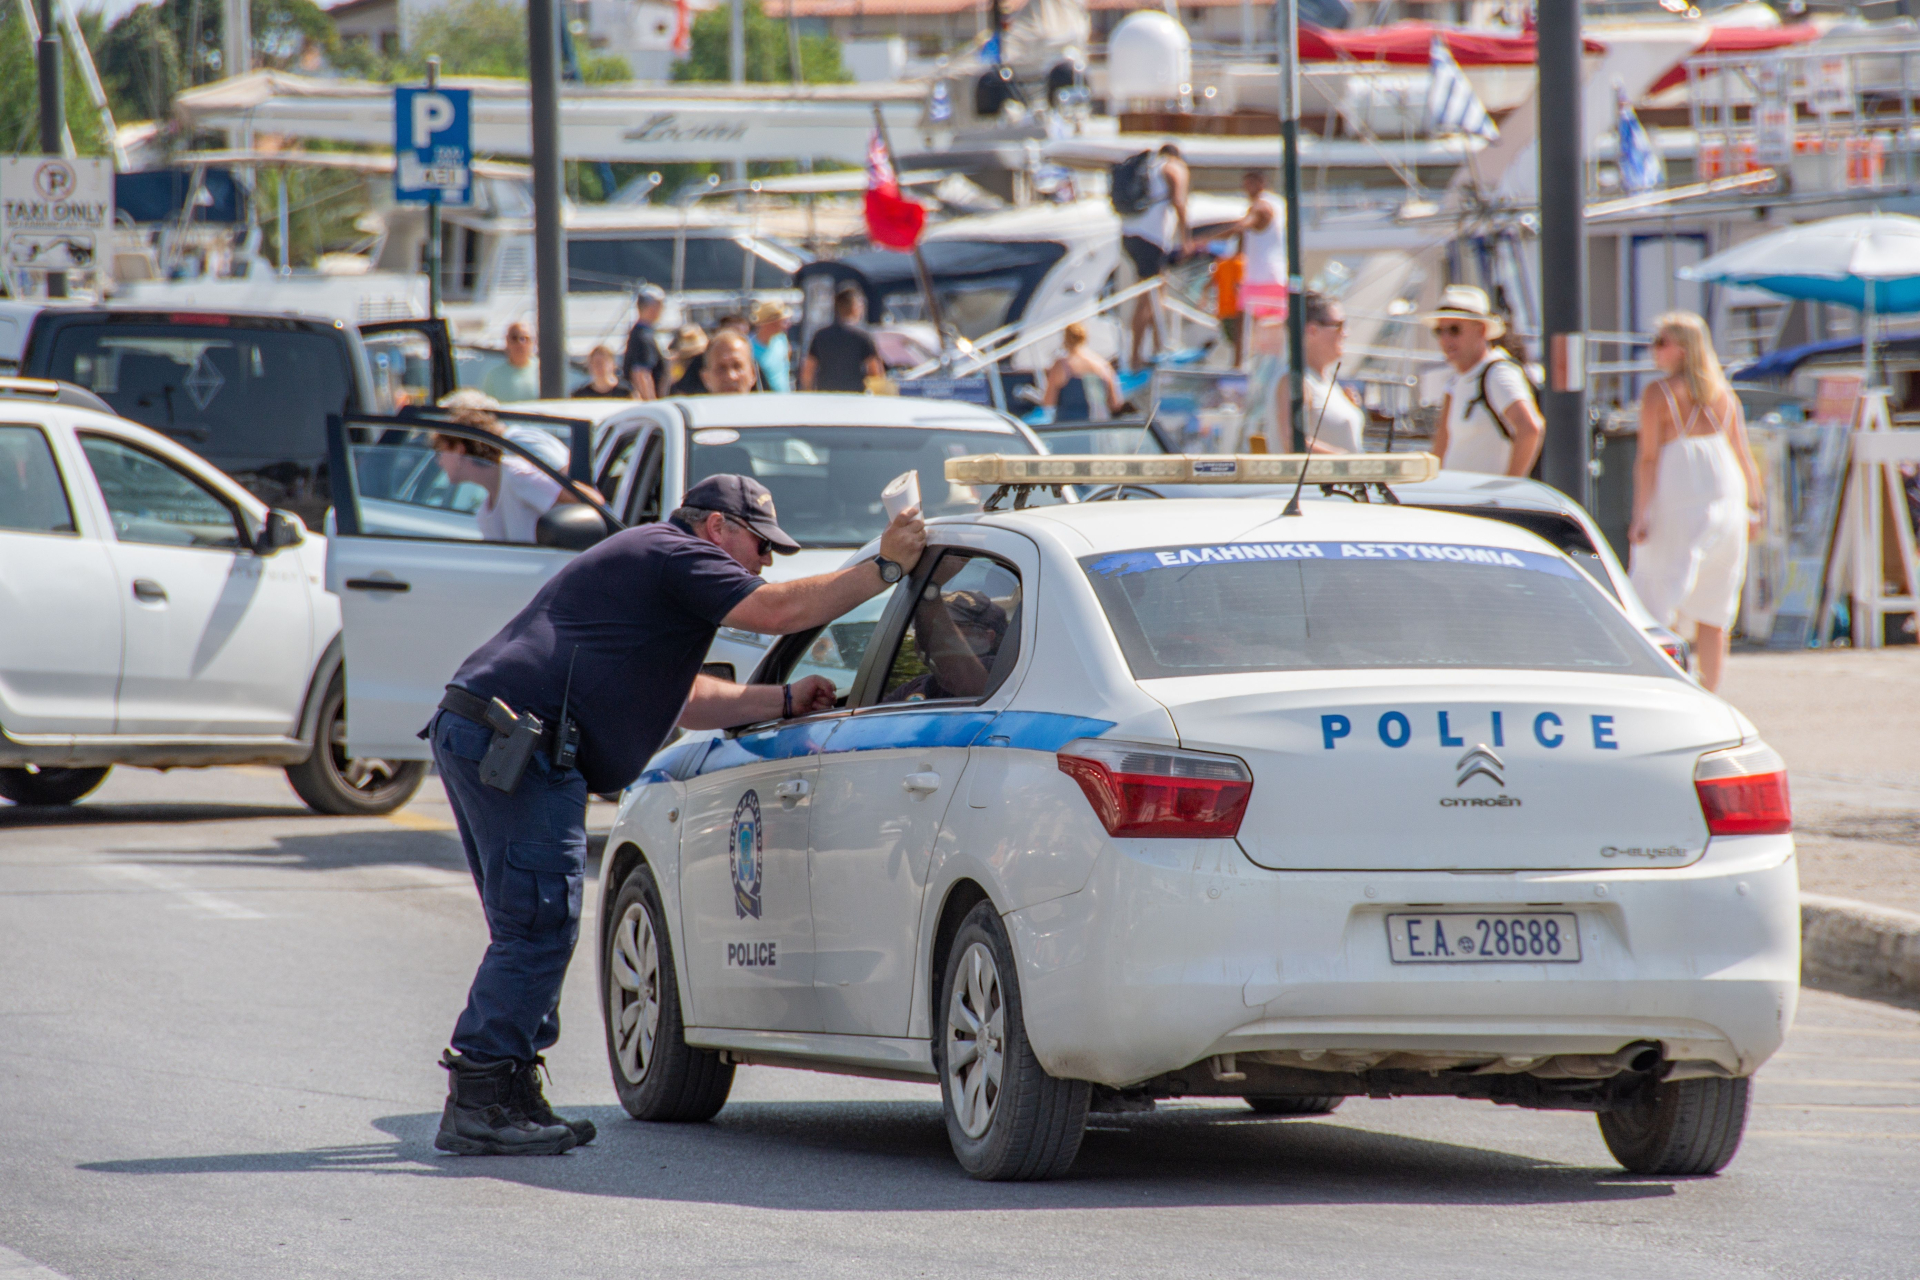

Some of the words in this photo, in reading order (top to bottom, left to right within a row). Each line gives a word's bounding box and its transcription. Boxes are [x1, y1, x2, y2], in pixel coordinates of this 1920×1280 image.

[411, 92, 456, 149] P
[5, 201, 48, 219] TAXI
[53, 201, 107, 221] ONLY
[1154, 543, 1324, 567] ΕΛΛΗΝΙΚΗ
[1341, 543, 1527, 568] ΑΣΤΥΝΟΜΙΑ
[1320, 710, 1620, 750] POLICE
[1476, 919, 1561, 956] 28688
[728, 942, 776, 967] POLICE
